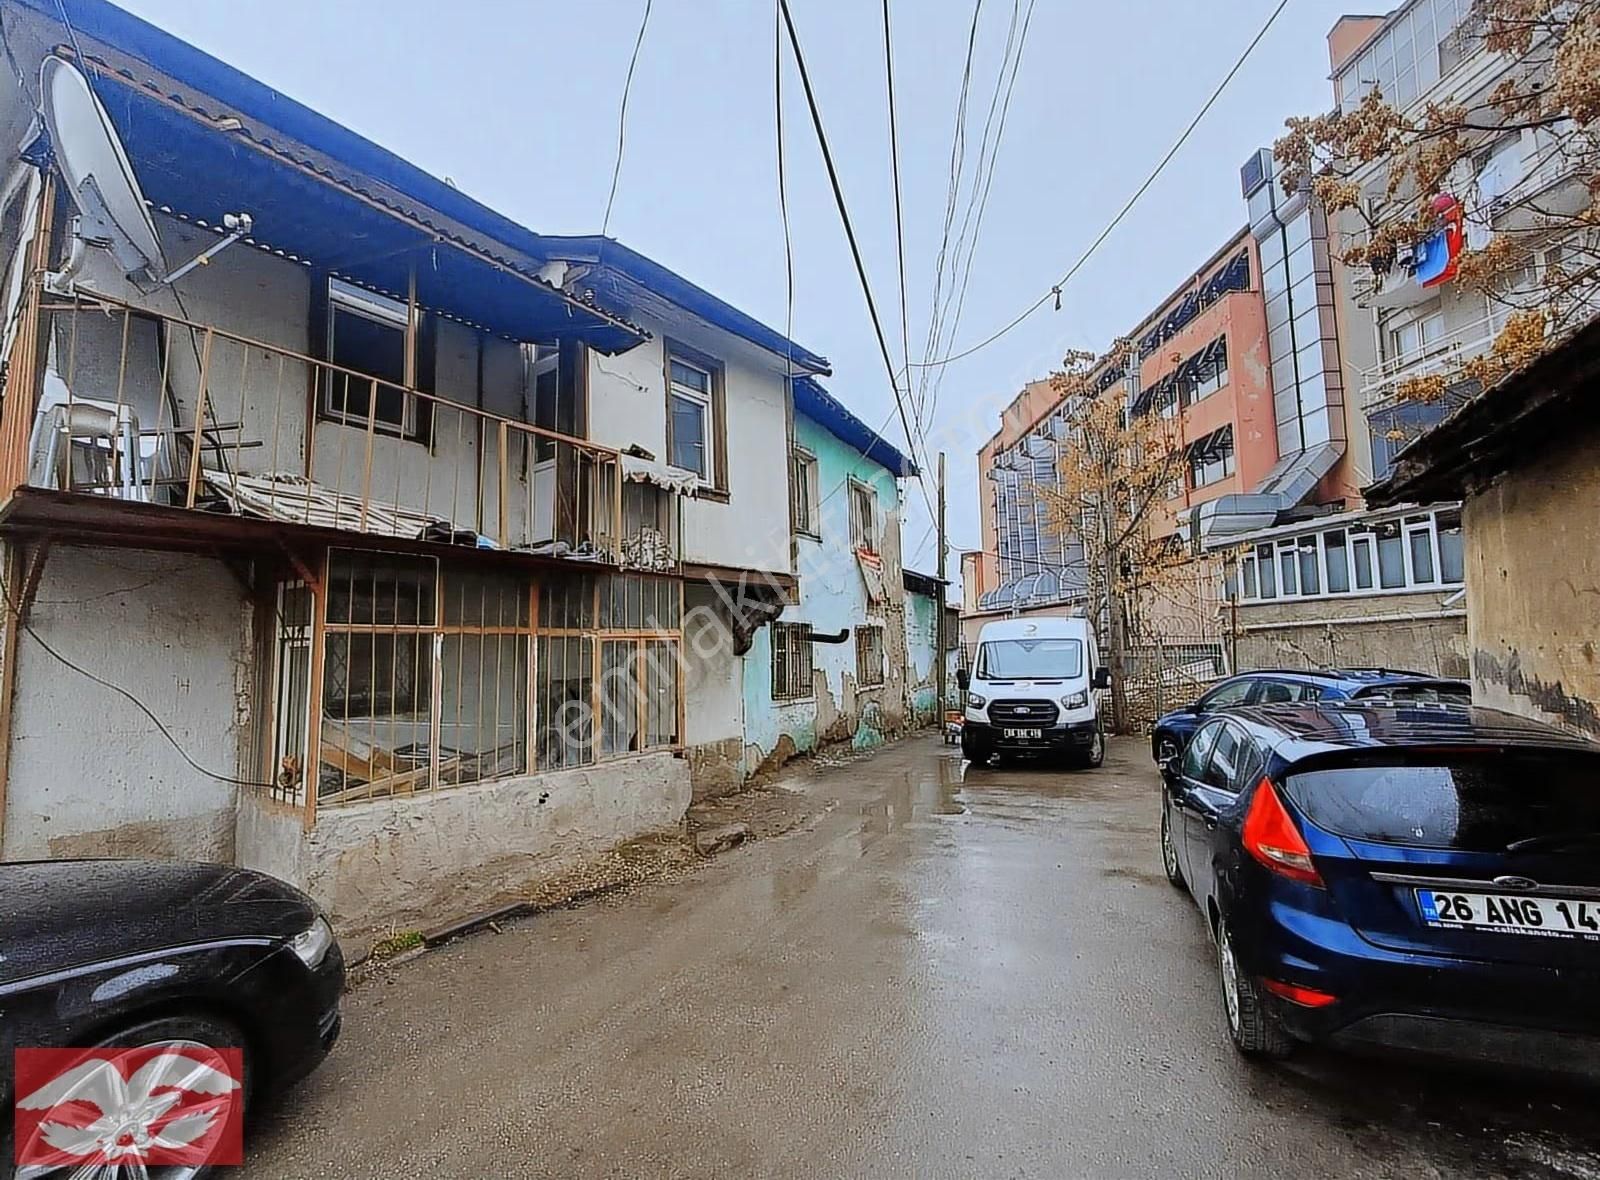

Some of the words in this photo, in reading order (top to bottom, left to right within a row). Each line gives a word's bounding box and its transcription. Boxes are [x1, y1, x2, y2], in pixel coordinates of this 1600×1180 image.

[1435, 894, 1473, 921] 26
[1486, 897, 1543, 926] ANG
[1556, 901, 1600, 931] 14
